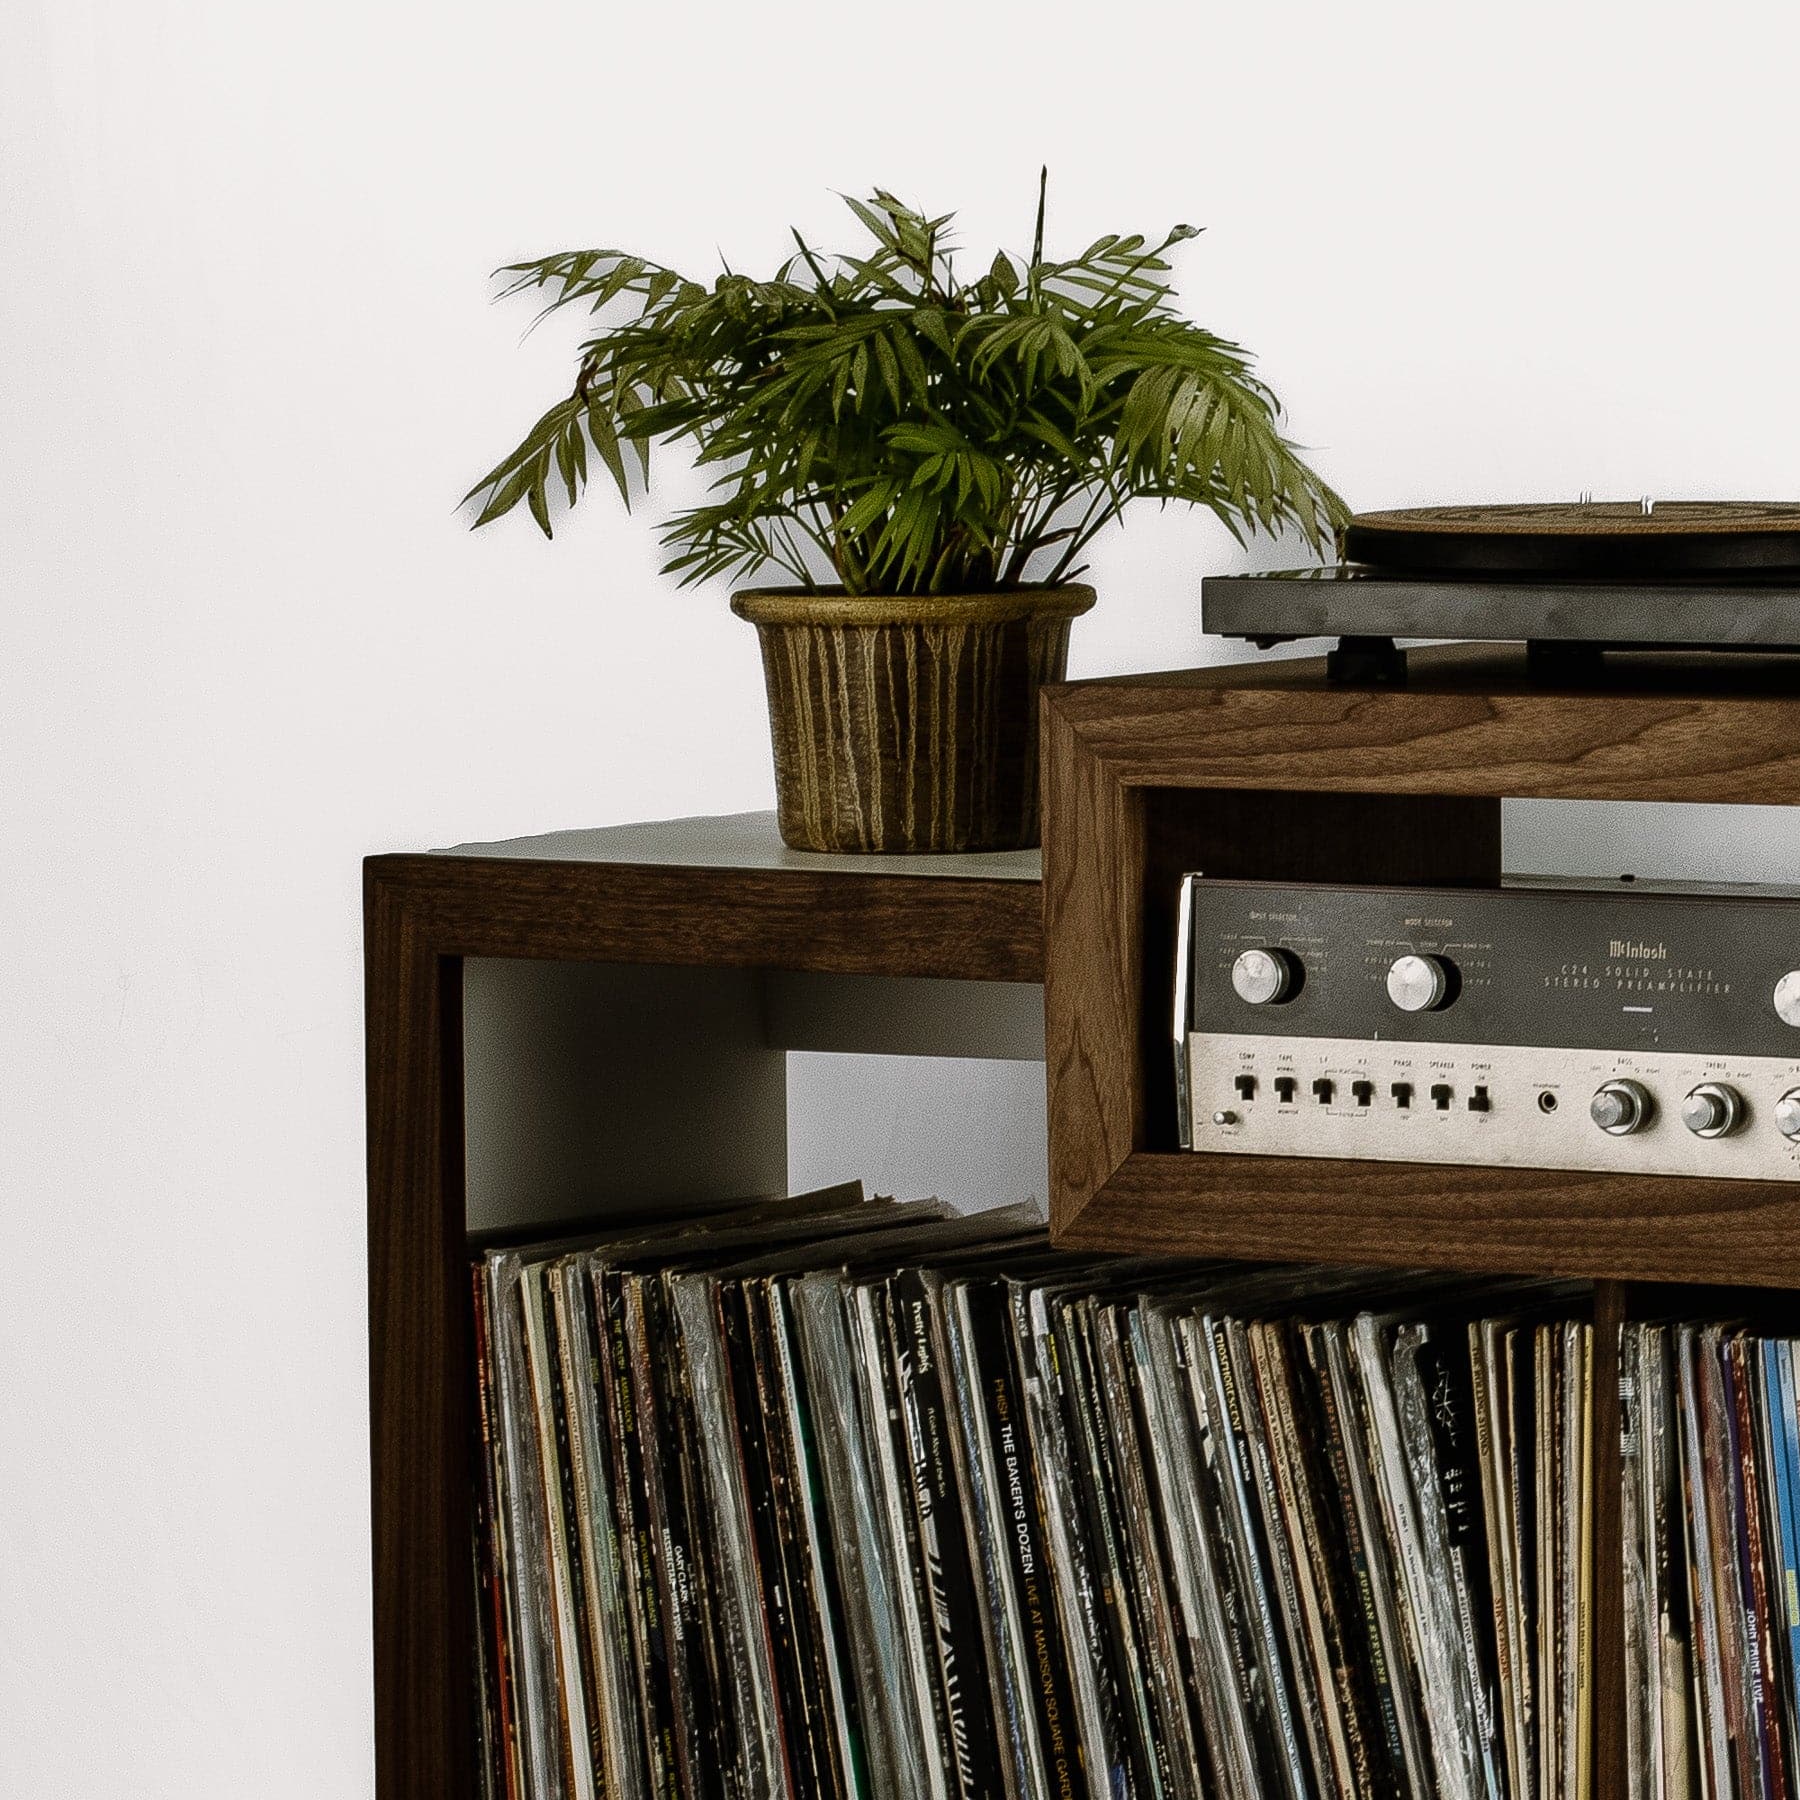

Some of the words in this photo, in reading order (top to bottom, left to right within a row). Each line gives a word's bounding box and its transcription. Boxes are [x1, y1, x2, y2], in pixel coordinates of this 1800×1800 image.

[1609, 940, 1667, 959] McIntosh
[1544, 976, 1600, 989] STEREO
[1605, 965, 1650, 978] SOLID
[909, 1301, 926, 1335] Pretty
[914, 1338, 931, 1373] Lights
[993, 1379, 1010, 1421] PHISH
[927, 1415, 938, 1435] Color
[1000, 1424, 1015, 1452] THE
[930, 1437, 941, 1456] Map
[1005, 1456, 1025, 1519] BAKER'S
[1318, 1369, 1340, 1444] ASTHMATIC
[1341, 1494, 1360, 1552] RECORDS
[1367, 1625, 1387, 1683] STEVENS
[673, 1545, 685, 1570] GARY
[1015, 1523, 1034, 1573] DOZEN
[1024, 1577, 1039, 1605] LIVE
[1028, 1609, 1042, 1624] AT
[1745, 1608, 1757, 1638] JOHN
[1032, 1629, 1054, 1693] MADISON
[1749, 1642, 1761, 1675] PRINE
[1752, 1679, 1764, 1703] LIVE
[1044, 1697, 1064, 1754] SQUARE
